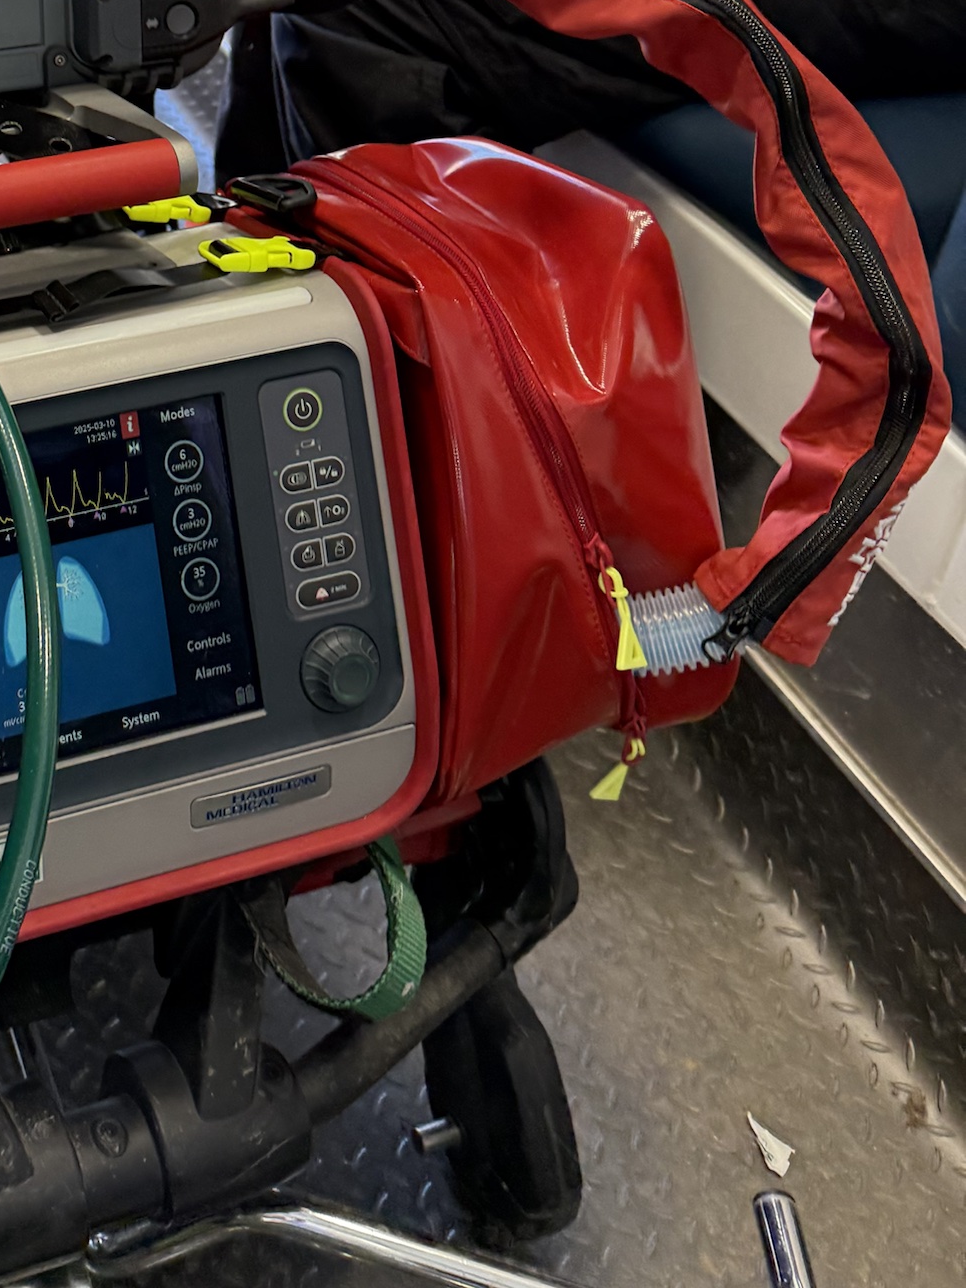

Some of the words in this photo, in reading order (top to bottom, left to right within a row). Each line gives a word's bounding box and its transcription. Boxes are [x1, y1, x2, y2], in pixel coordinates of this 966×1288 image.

[160, 406, 196, 424] Modes
[74, 419, 116, 435] 2025-03-10
[179, 449, 186, 461] 6
[171, 459, 198, 473] cmH2O
[187, 508, 195, 519] 3
[4, 533, 11, 542] 4
[128, 505, 137, 514] 12
[179, 516, 205, 531] cmH2O
[173, 537, 219, 558] PEEP/CPAP
[193, 566, 206, 579] 35
[188, 598, 221, 615] Oxygen
[187, 632, 232, 653] Controls
[195, 663, 232, 681] Alarms
[59, 729, 83, 745] ents
[122, 709, 161, 729] System
[232, 774, 317, 804] HAMILTON
[206, 796, 278, 821] MEDICAL
[0, 859, 37, 956] CONDUCTIVE
